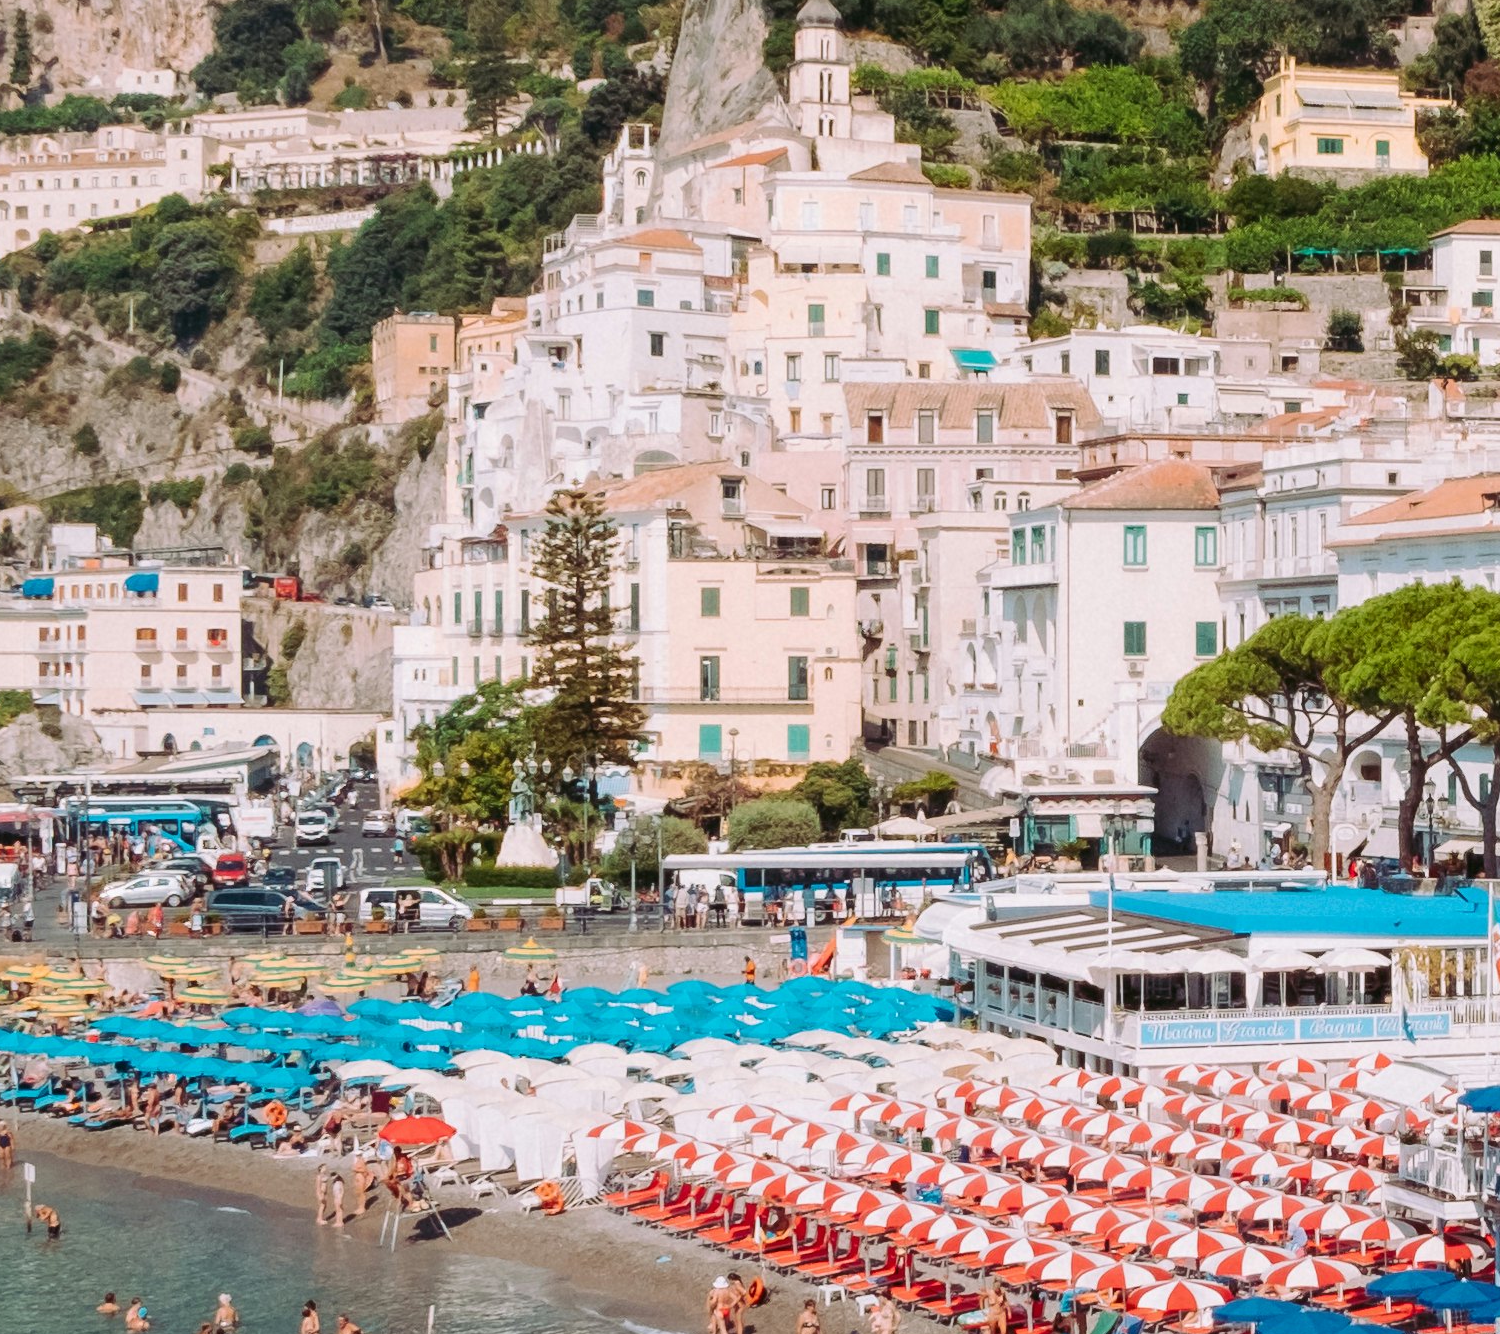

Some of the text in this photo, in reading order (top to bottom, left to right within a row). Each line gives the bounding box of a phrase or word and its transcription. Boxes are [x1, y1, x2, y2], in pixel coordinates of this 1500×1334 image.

[1148, 1021, 1214, 1041] Marina
[1221, 1020, 1287, 1042] Grande
[1309, 1017, 1364, 1037] Bagni
